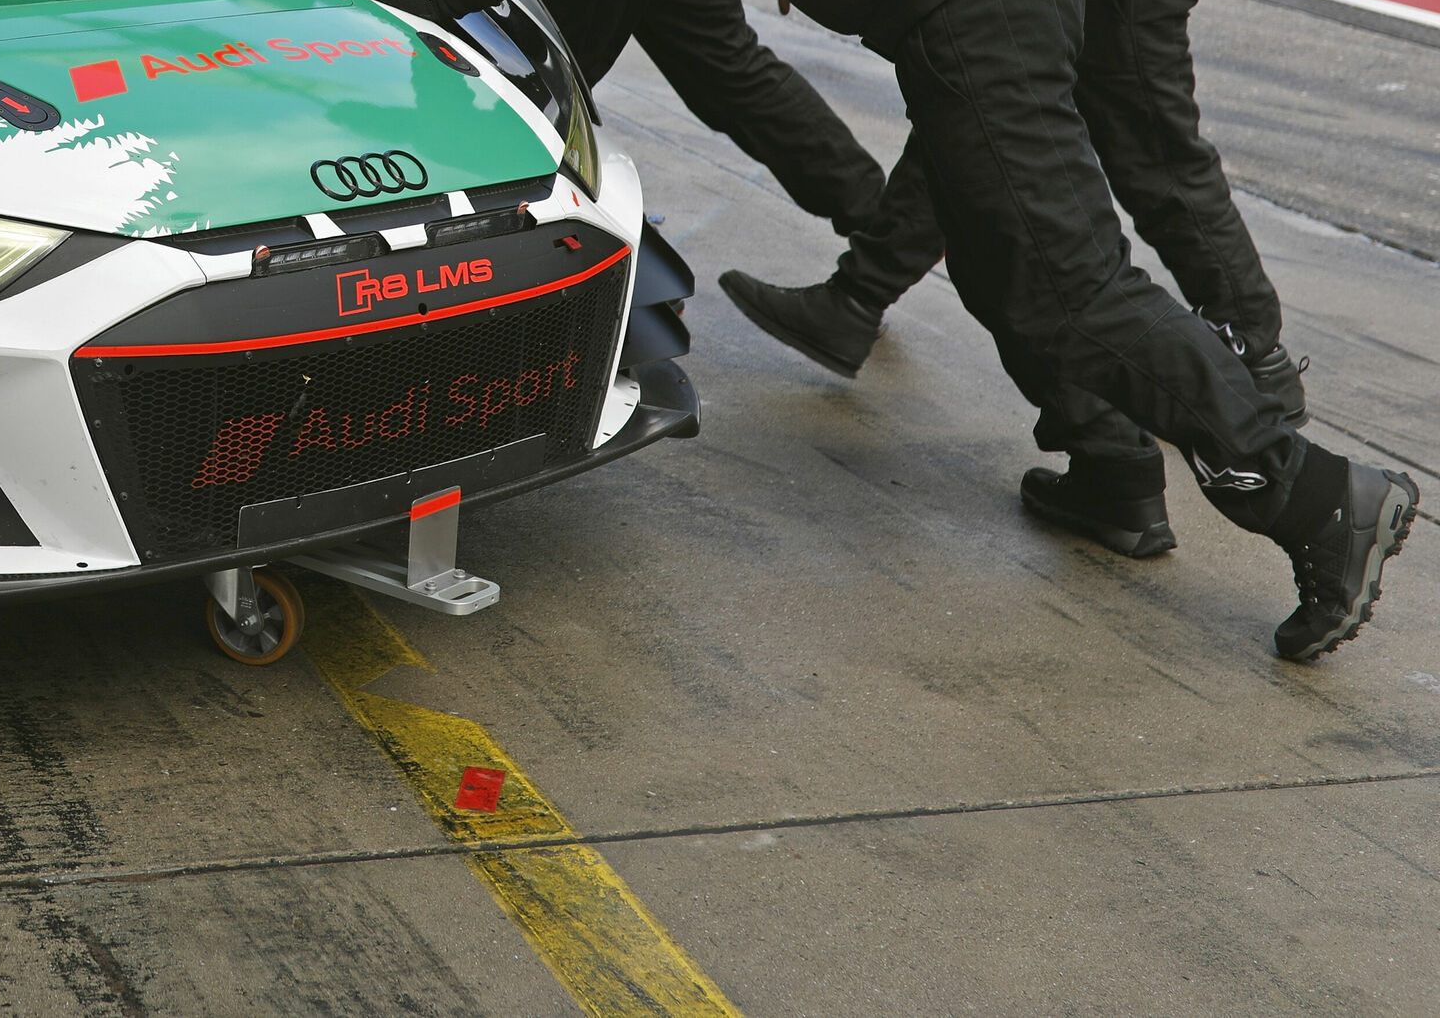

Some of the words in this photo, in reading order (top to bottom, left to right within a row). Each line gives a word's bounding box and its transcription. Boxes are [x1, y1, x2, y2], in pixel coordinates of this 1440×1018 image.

[139, 42, 268, 80] Audi
[266, 37, 418, 64] Sport
[416, 258, 493, 293] LMS
[289, 386, 430, 457] Audi
[445, 350, 580, 430] Sport
